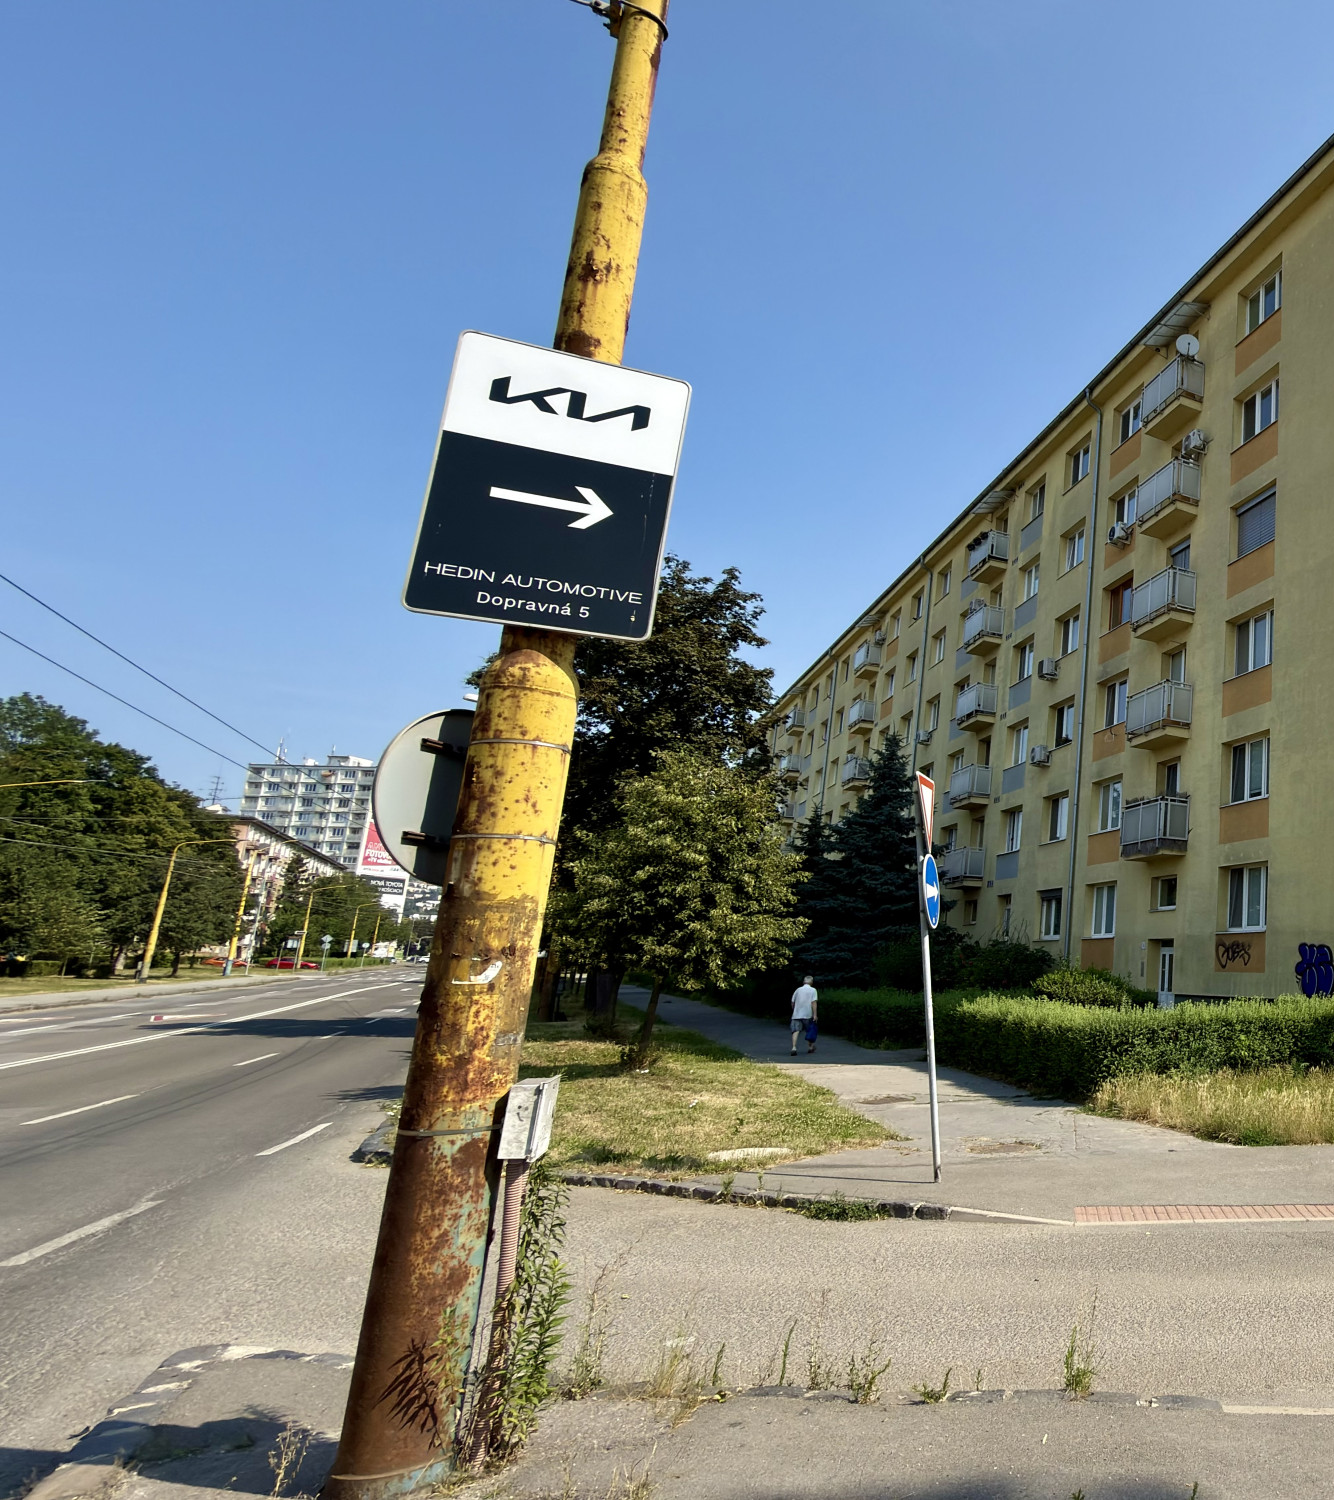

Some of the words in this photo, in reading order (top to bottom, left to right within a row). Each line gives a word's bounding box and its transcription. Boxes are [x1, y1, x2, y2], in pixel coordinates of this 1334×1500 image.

[489, 376, 651, 431] KIA
[424, 561, 495, 583] HEDIN
[501, 573, 642, 605] AUTOMOTIVE
[476, 591, 571, 616] Dopravná
[578, 606, 590, 618] 5
[370, 879, 384, 887] NOVÁ
